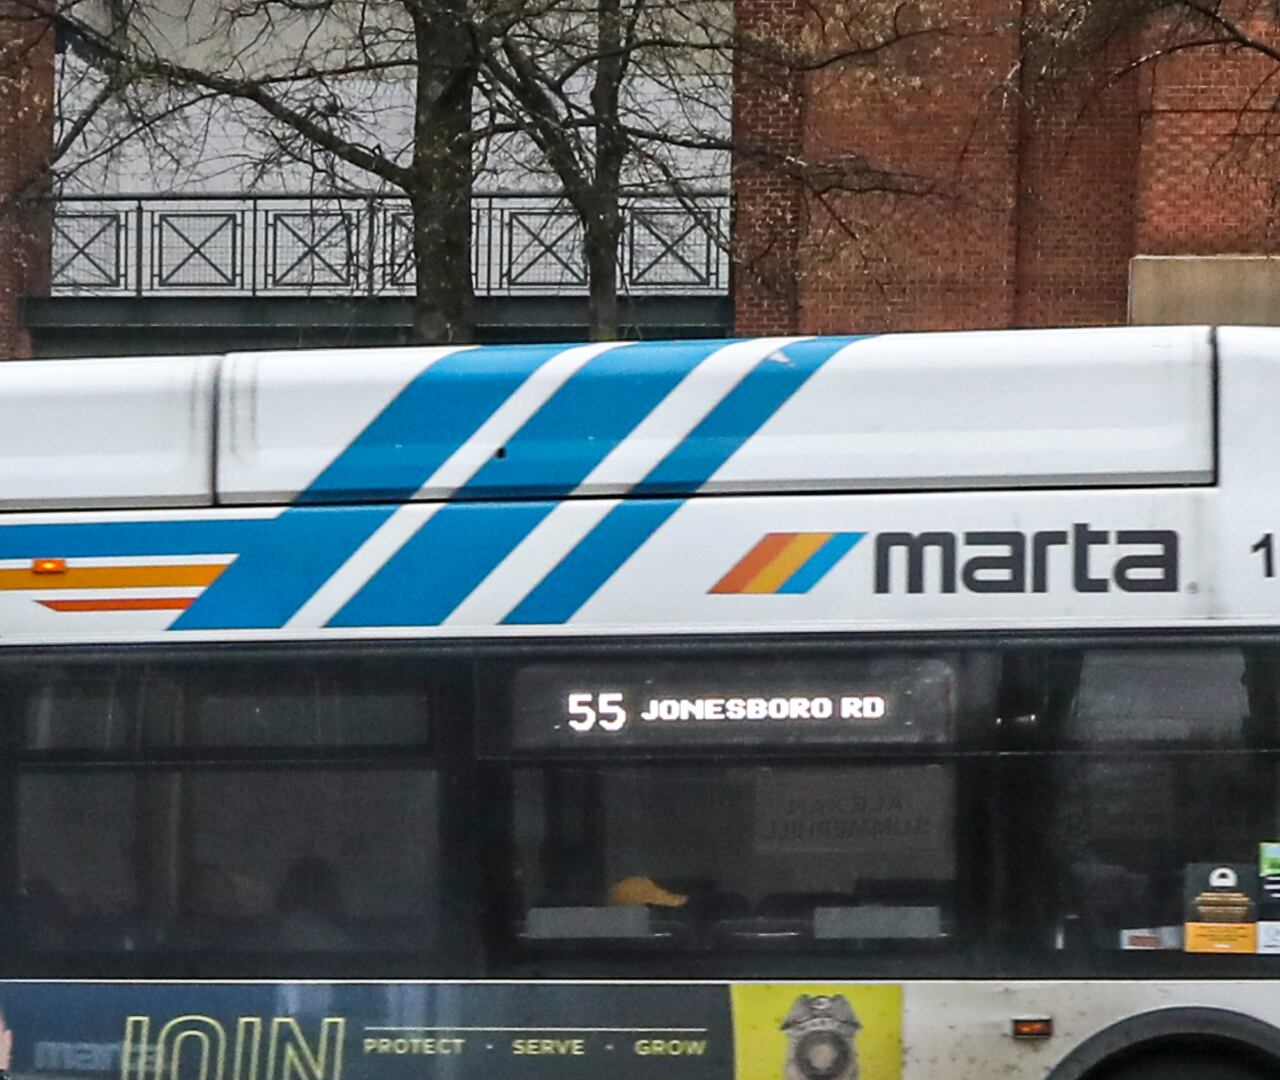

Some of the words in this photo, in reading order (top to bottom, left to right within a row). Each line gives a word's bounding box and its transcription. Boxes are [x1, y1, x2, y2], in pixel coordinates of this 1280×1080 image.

[875, 523, 1179, 594] marta
[568, 692, 627, 732] 55
[640, 696, 833, 721] JONESBORO
[840, 696, 886, 719] RD
[363, 1037, 465, 1055] PROTECT
[512, 1038, 585, 1056] SERVE
[634, 1038, 707, 1057] GROW
